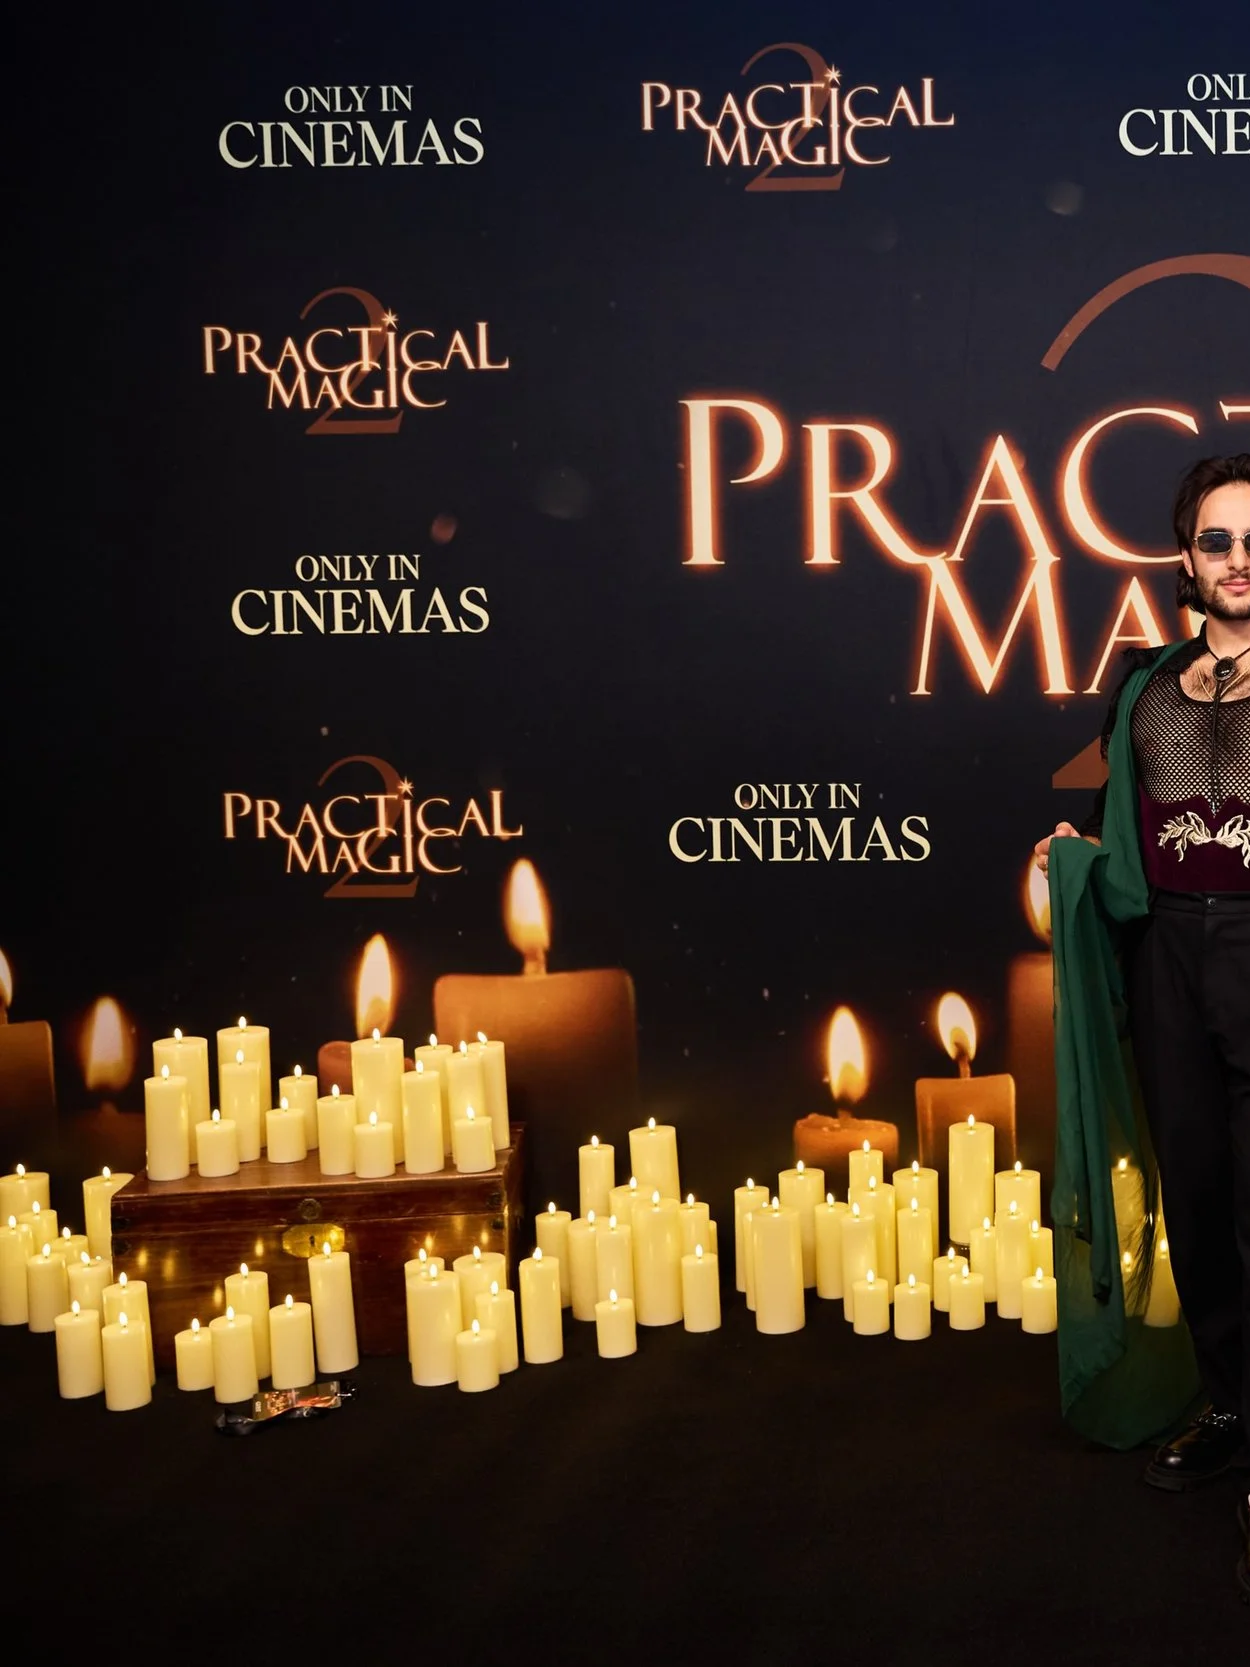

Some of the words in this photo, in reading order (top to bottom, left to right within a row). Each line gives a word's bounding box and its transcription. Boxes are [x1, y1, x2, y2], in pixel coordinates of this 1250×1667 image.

[285, 86, 371, 113] ONLY
[379, 85, 413, 112] IN
[641, 77, 955, 131] PRACTICAL
[218, 118, 485, 169] CINEMAS
[705, 117, 891, 167] MAGIC
[202, 321, 510, 374] PRACTICAL
[267, 360, 448, 410] MAGIC
[295, 555, 380, 582] ONLY
[388, 554, 421, 581] IN
[231, 587, 490, 636] CINEMAS
[222, 790, 524, 839] PRACTICAL
[735, 783, 820, 810] ONLY
[828, 783, 862, 809] IN
[286, 827, 463, 874] MAGIC
[668, 815, 931, 863] CINEMAS
